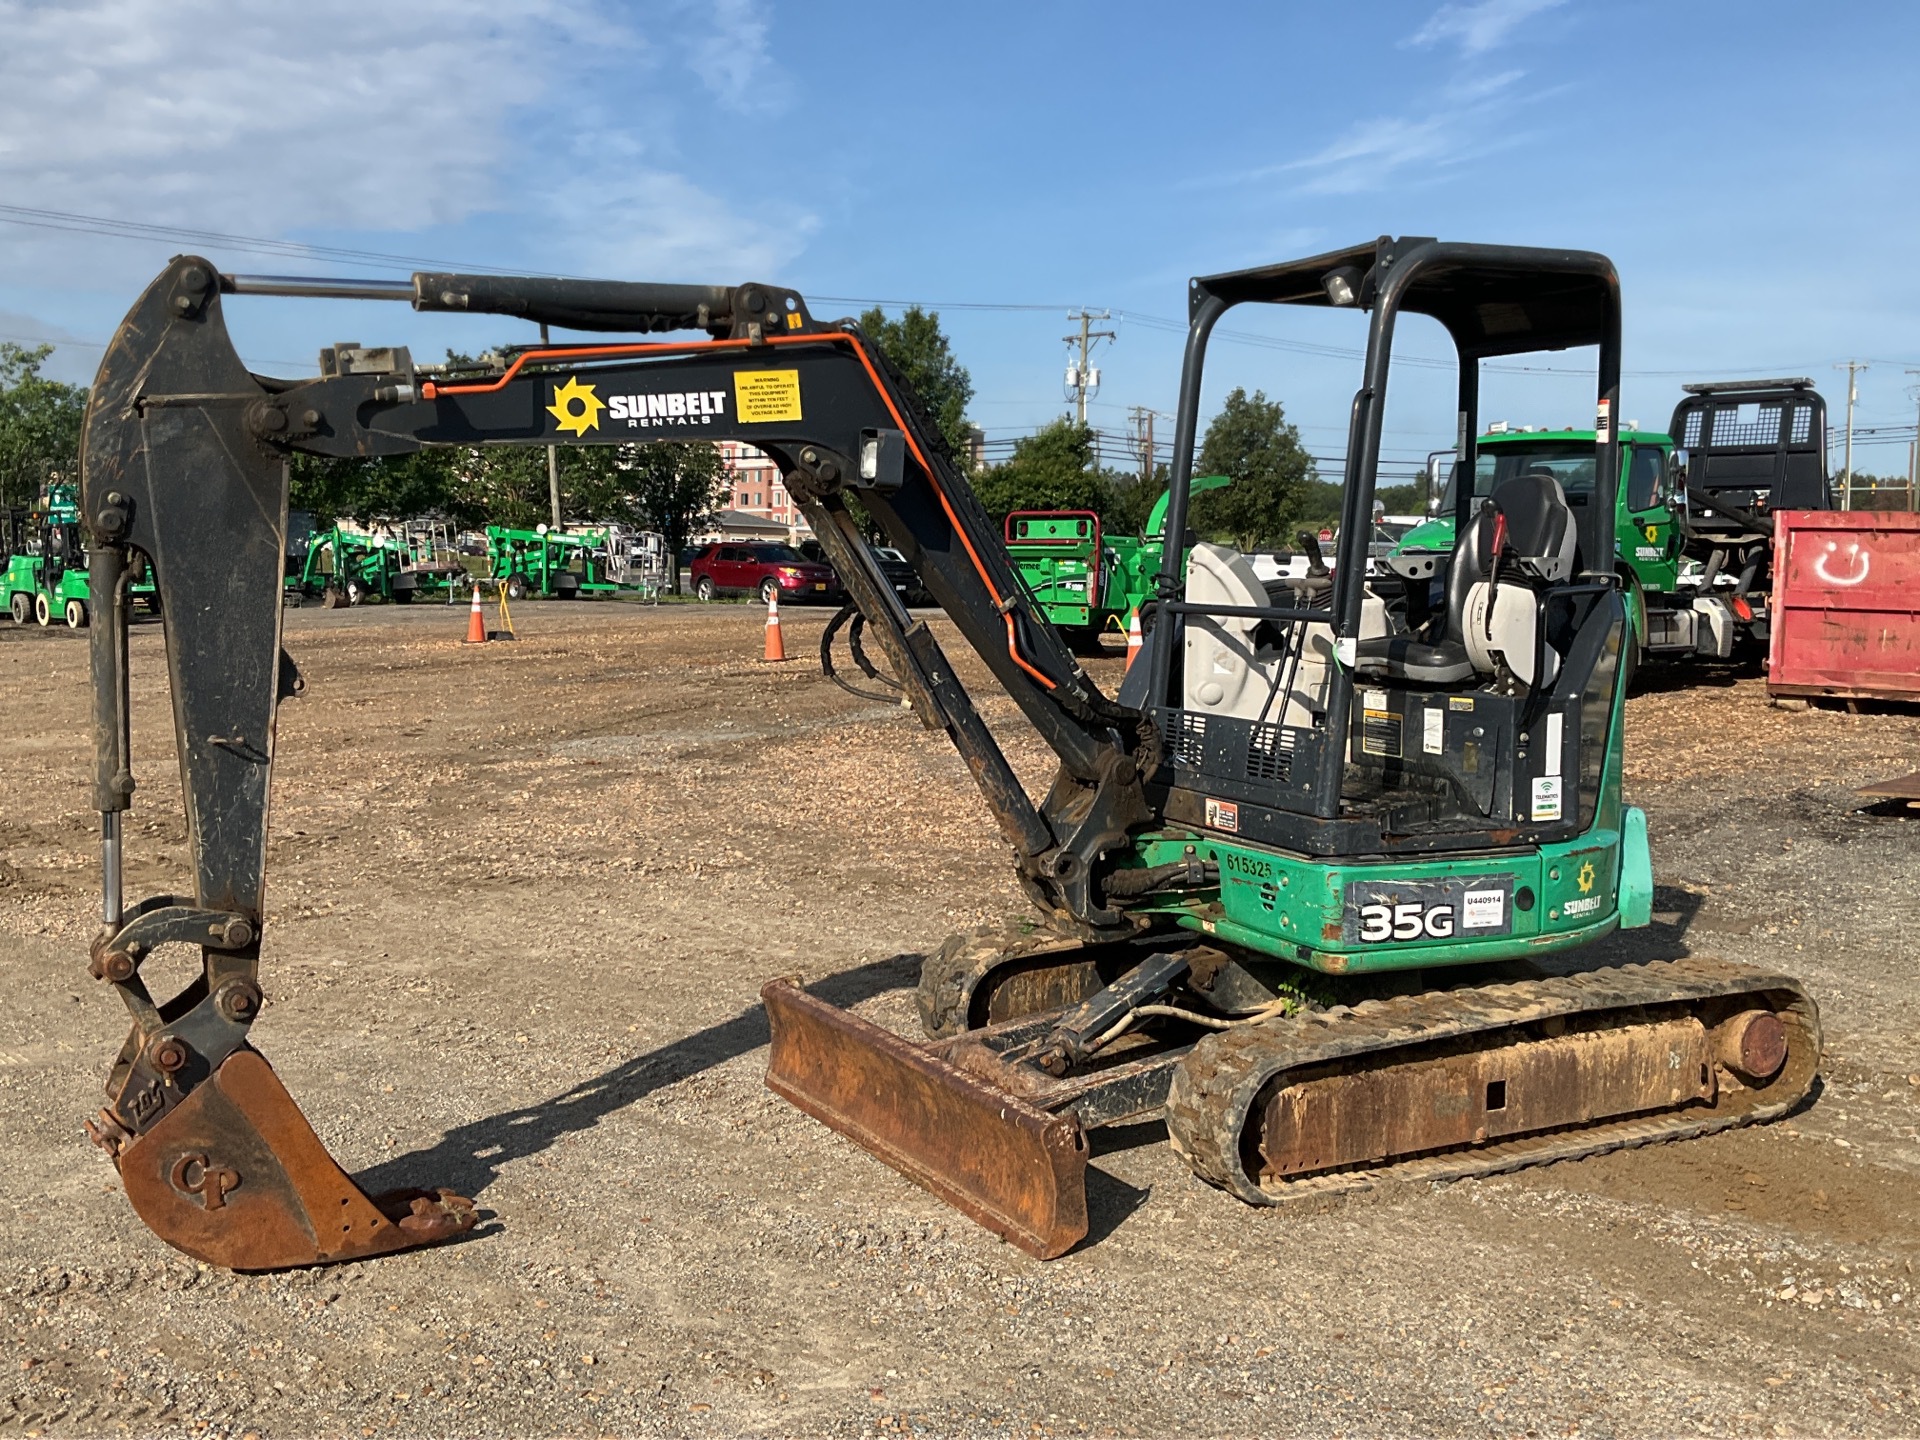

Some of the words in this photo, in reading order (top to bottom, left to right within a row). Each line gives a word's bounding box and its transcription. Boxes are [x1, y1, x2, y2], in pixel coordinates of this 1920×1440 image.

[608, 391, 726, 419] SUNBELT
[628, 416, 711, 428] RENTALS
[1227, 854, 1272, 878] 615325
[1467, 896, 1501, 905] U440914
[1564, 895, 1602, 915] SUNBELT
[1360, 902, 1454, 943] 35G
